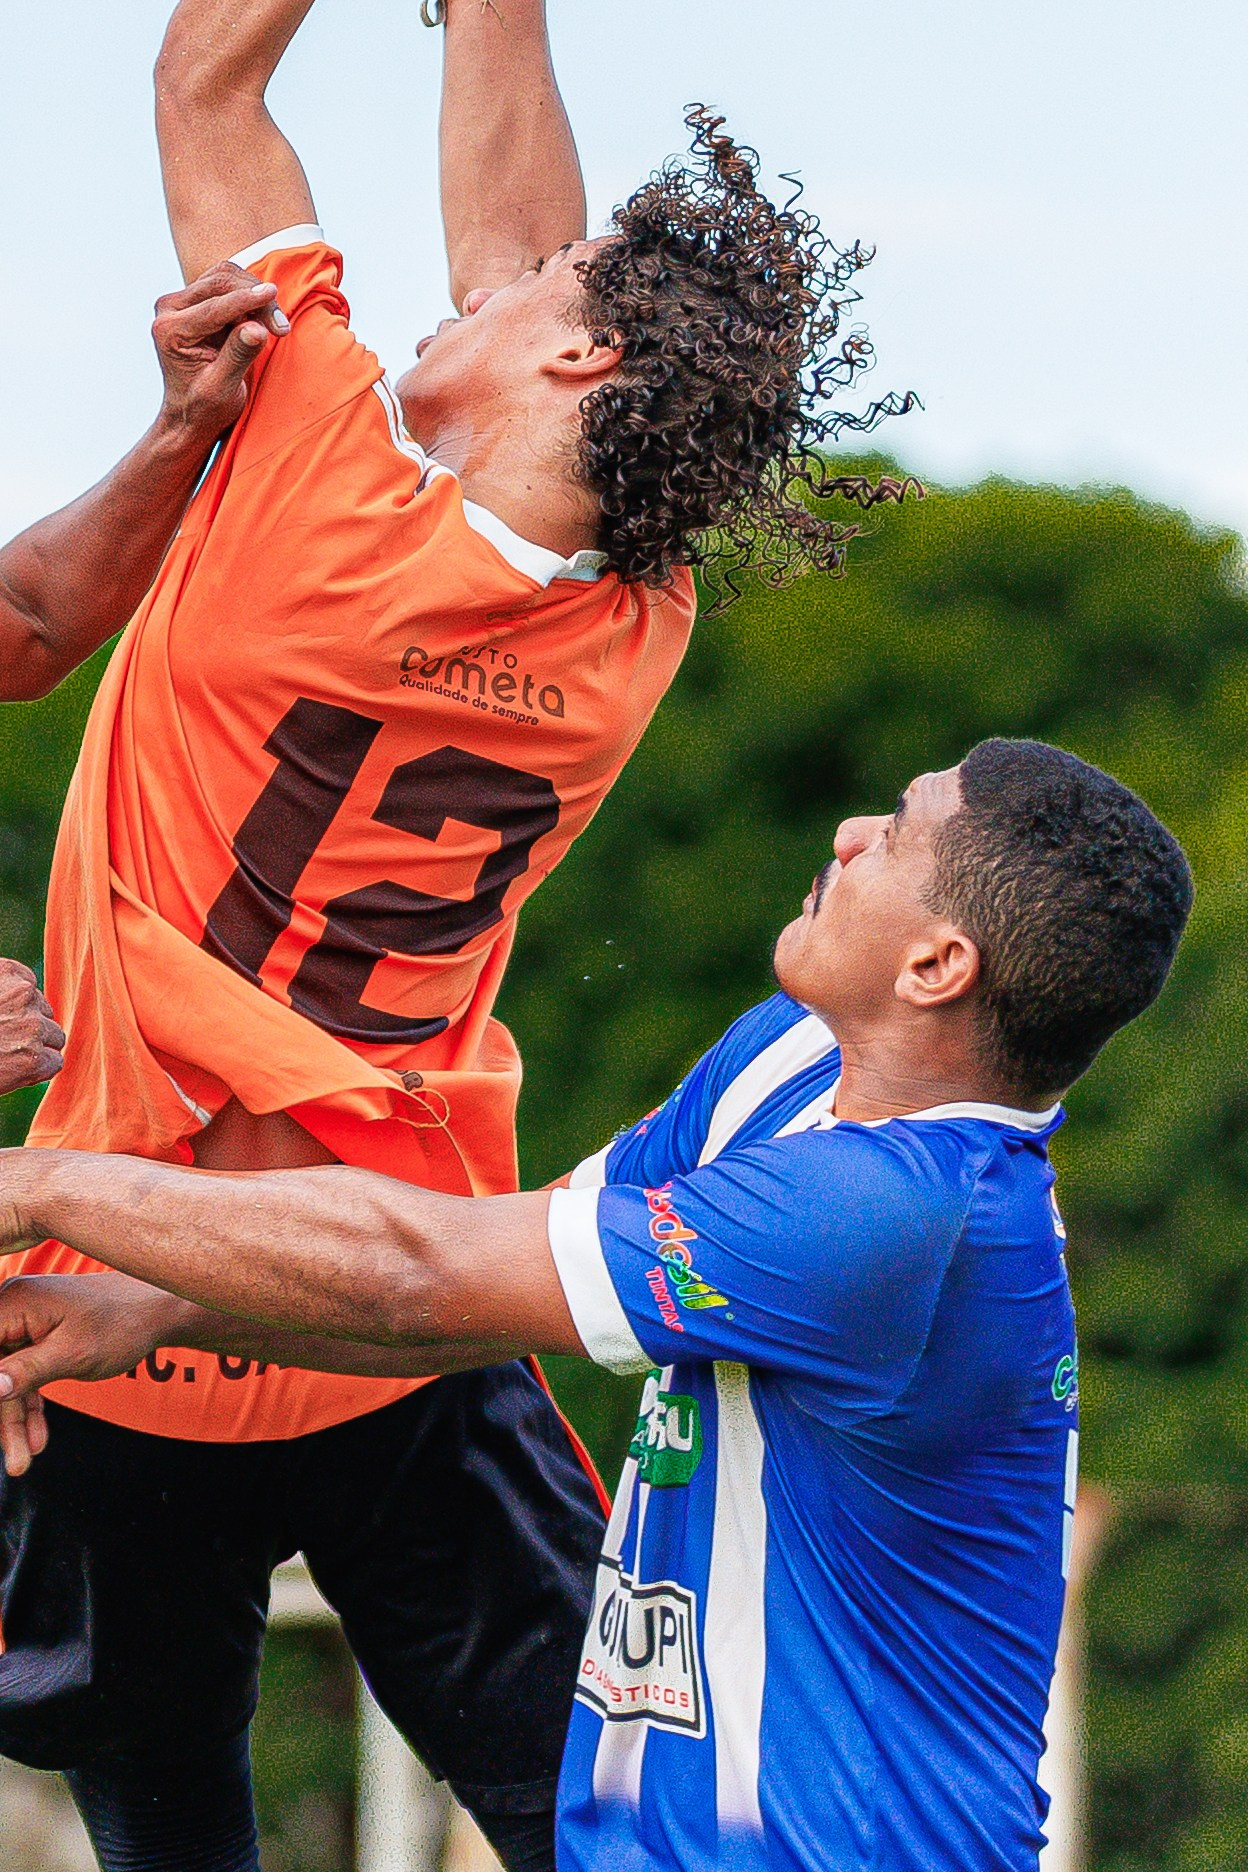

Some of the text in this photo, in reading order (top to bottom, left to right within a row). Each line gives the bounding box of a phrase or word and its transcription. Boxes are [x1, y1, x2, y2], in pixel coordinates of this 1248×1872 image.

[399, 674, 540, 726] Qualidade de sempre
[198, 696, 561, 1045] 12
